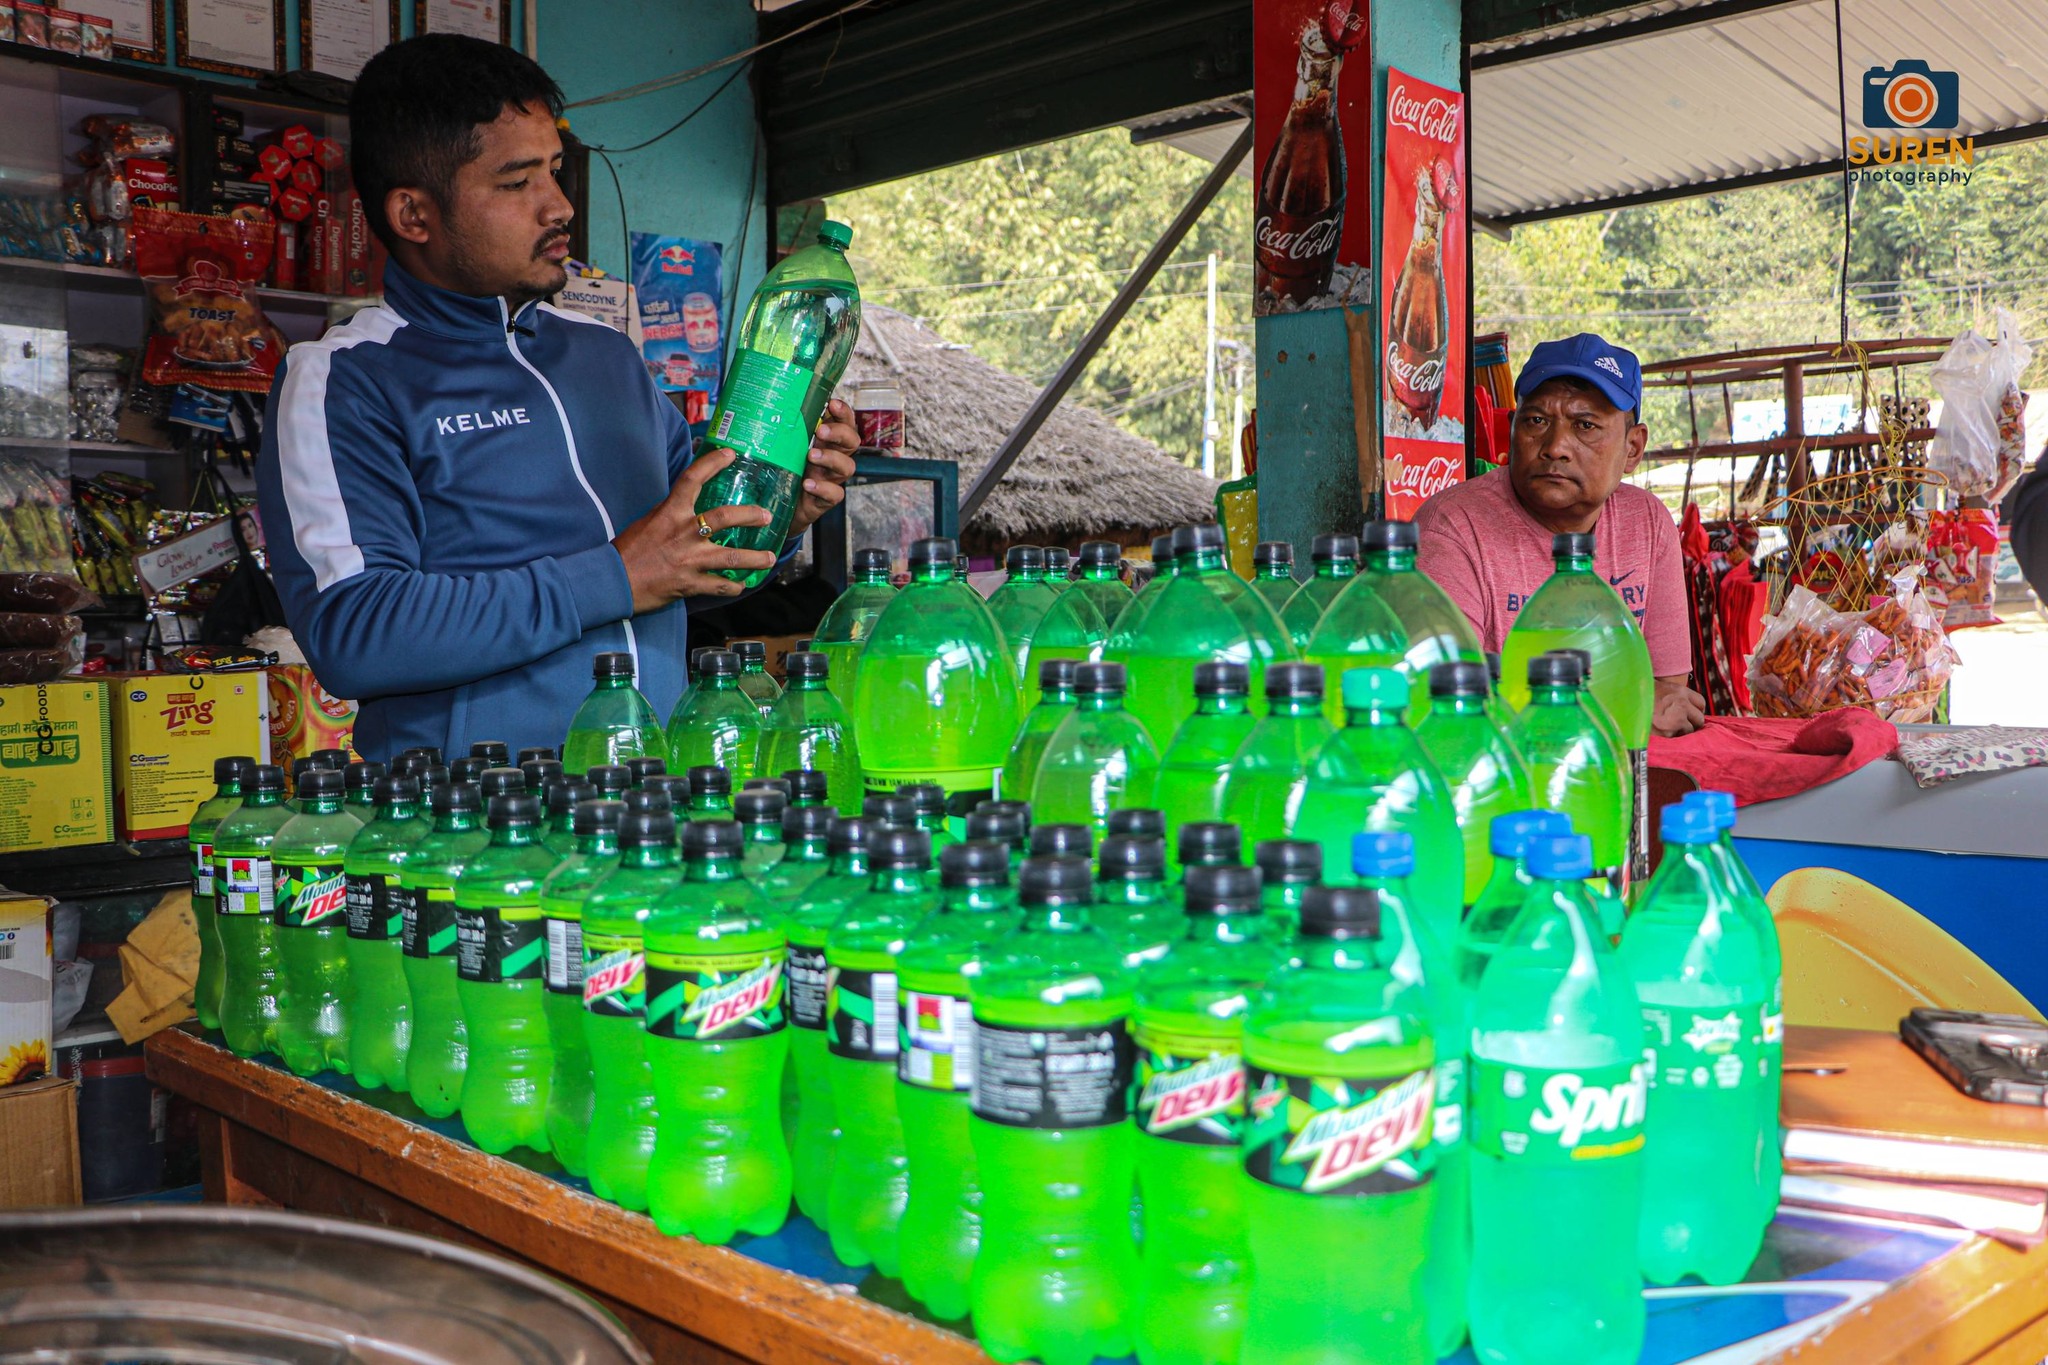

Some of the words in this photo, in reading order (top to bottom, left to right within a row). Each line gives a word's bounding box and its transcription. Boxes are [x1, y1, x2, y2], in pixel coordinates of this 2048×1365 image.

[1389, 85, 1461, 143] Coca-Cola
[128, 178, 178, 193] ChocoPie
[562, 291, 617, 306] SENSODYNE
[189, 307, 236, 322] TOAST
[643, 323, 684, 340] NERGY
[1594, 359, 1624, 379] adidas
[436, 407, 531, 435] KELME
[37, 684, 49, 721] FOODS
[131, 692, 147, 701] CG
[159, 699, 216, 730] Zing
[129, 754, 145, 762] CG
[53, 824, 71, 834] CG
